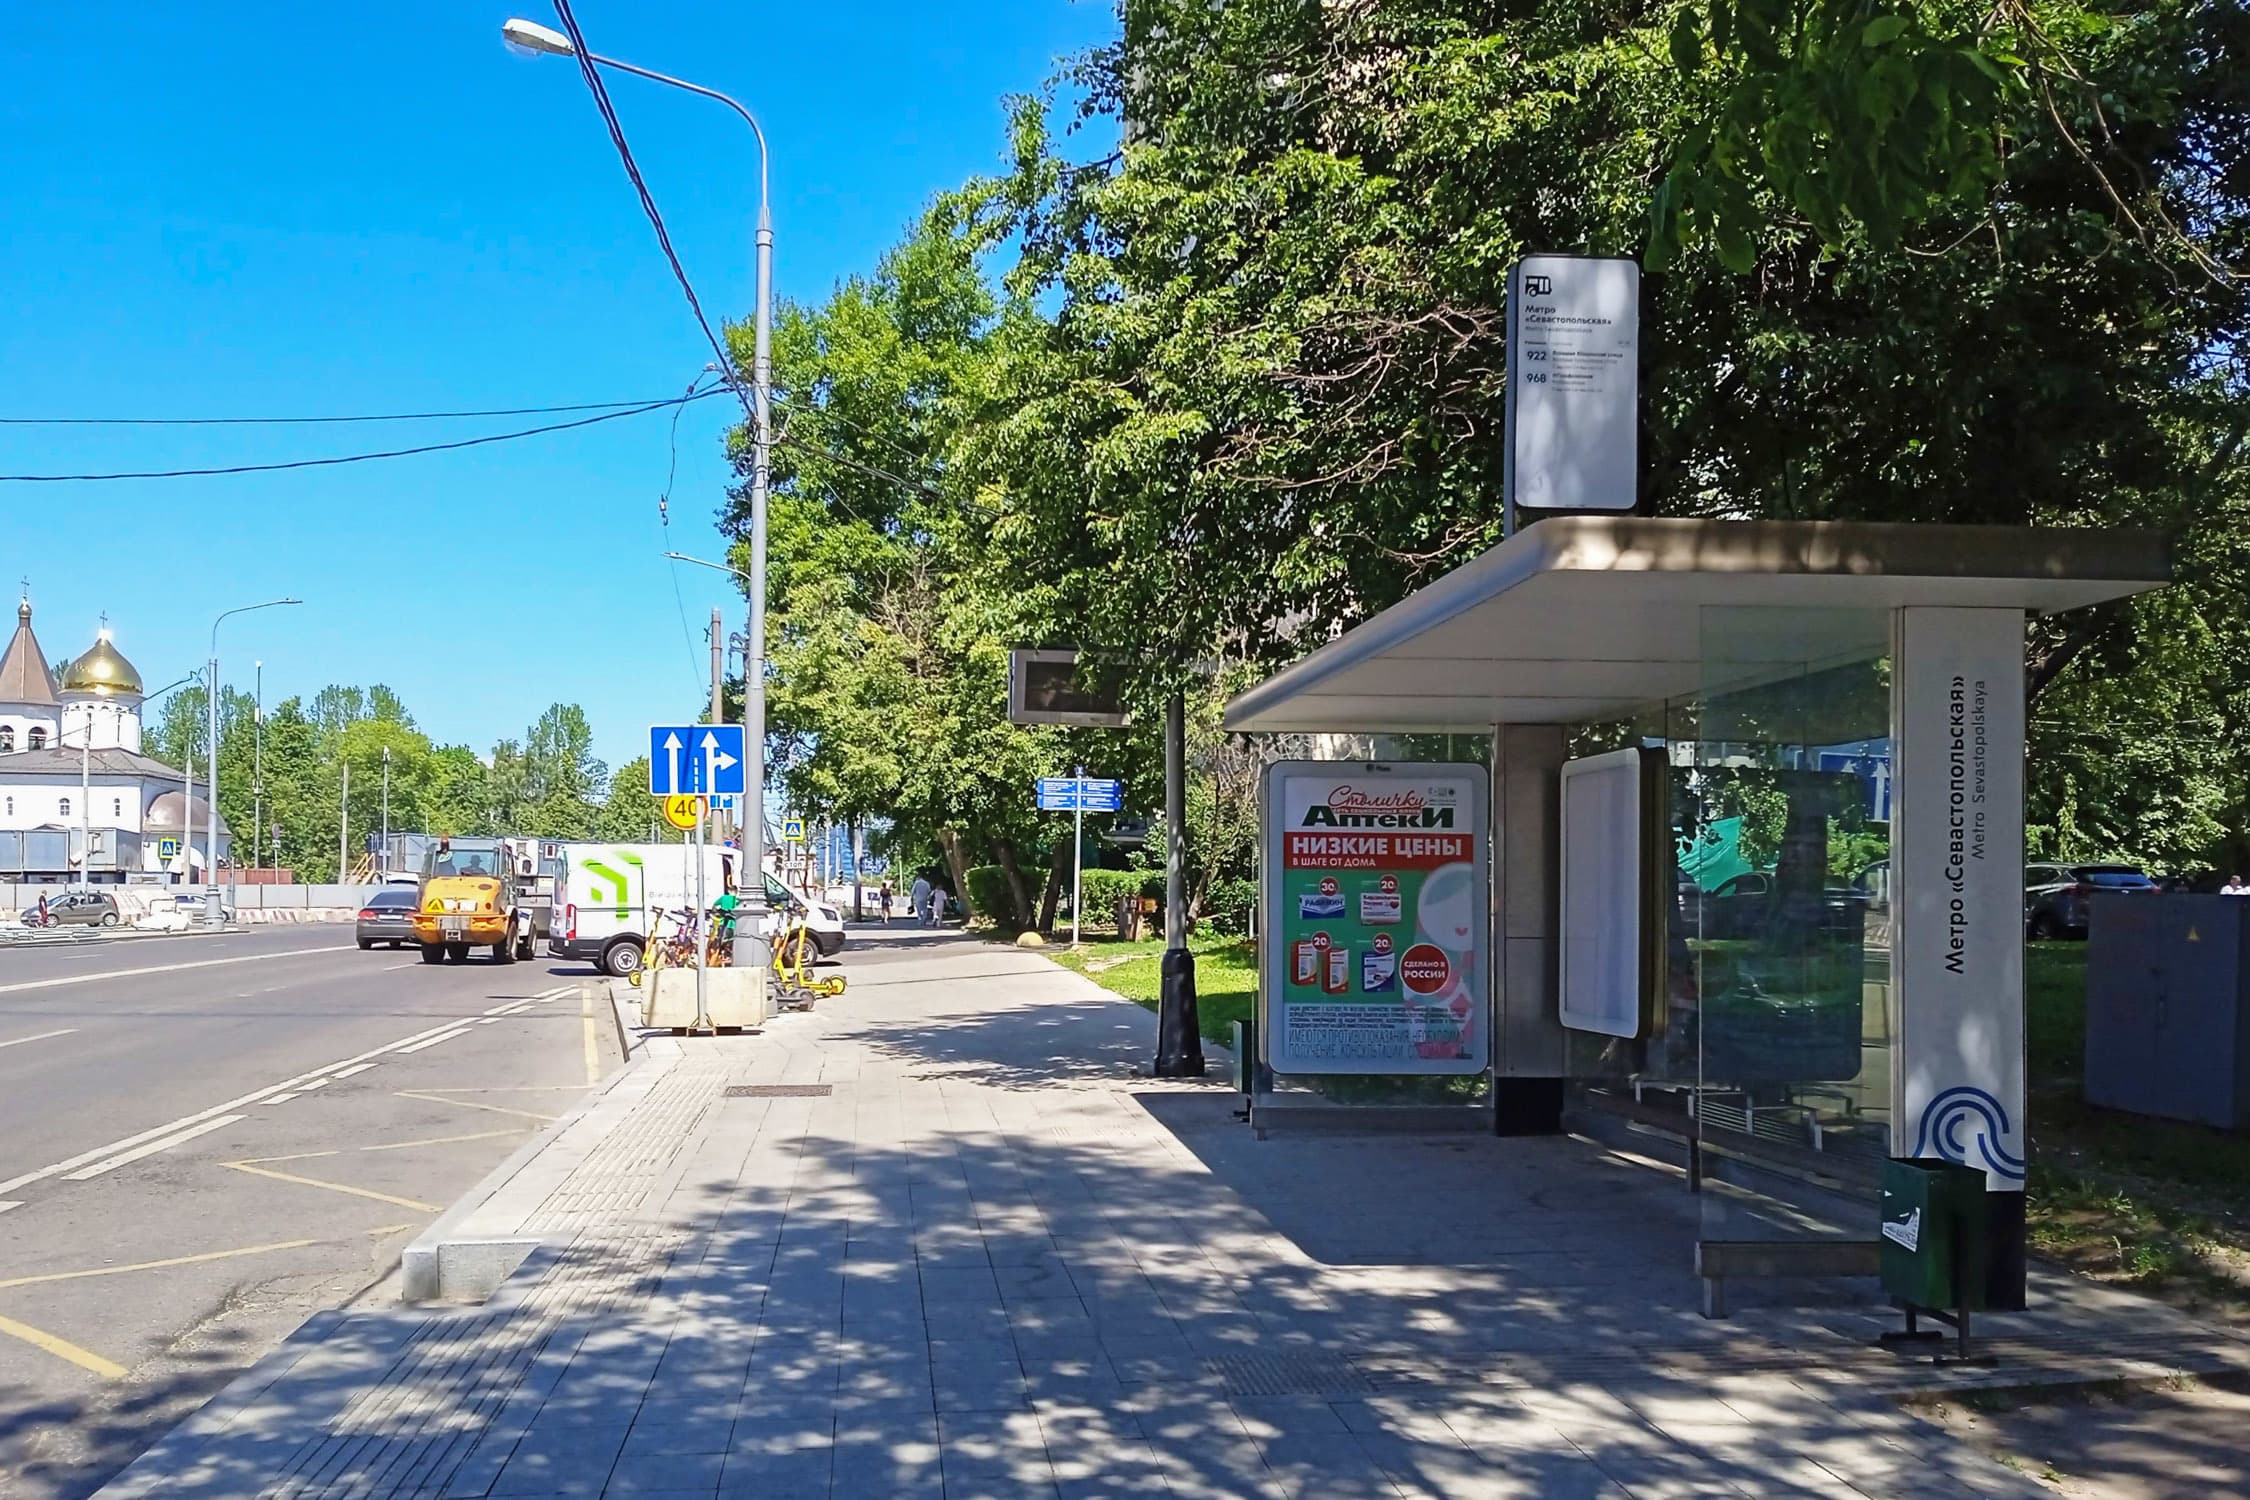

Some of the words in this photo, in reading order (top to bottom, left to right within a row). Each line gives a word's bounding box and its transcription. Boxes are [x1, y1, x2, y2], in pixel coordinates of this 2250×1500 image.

[1525, 305, 1556, 315] Метро
[1525, 315, 1612, 325] «Севастопольская»
[1527, 351, 1546, 361] 922
[1526, 373, 1546, 383] 968
[1971, 680, 1988, 803] Sevastopolskaya
[1944, 676, 1966, 892] «Севастопольская»
[1328, 785, 1427, 807] Столички
[674, 800, 696, 816] 40
[1971, 812, 1985, 859] Metro
[1292, 837, 1388, 855] НИЗКИЕ
[1395, 838, 1462, 858] ЦЕНЫ
[1292, 857, 1299, 866] В
[1301, 857, 1327, 866] ШАГЕ
[1329, 858, 1342, 866] ОТ
[1344, 858, 1376, 867] ДОМА
[1944, 899, 1968, 974] Метро
[1404, 970, 1446, 979] РОССИИ
